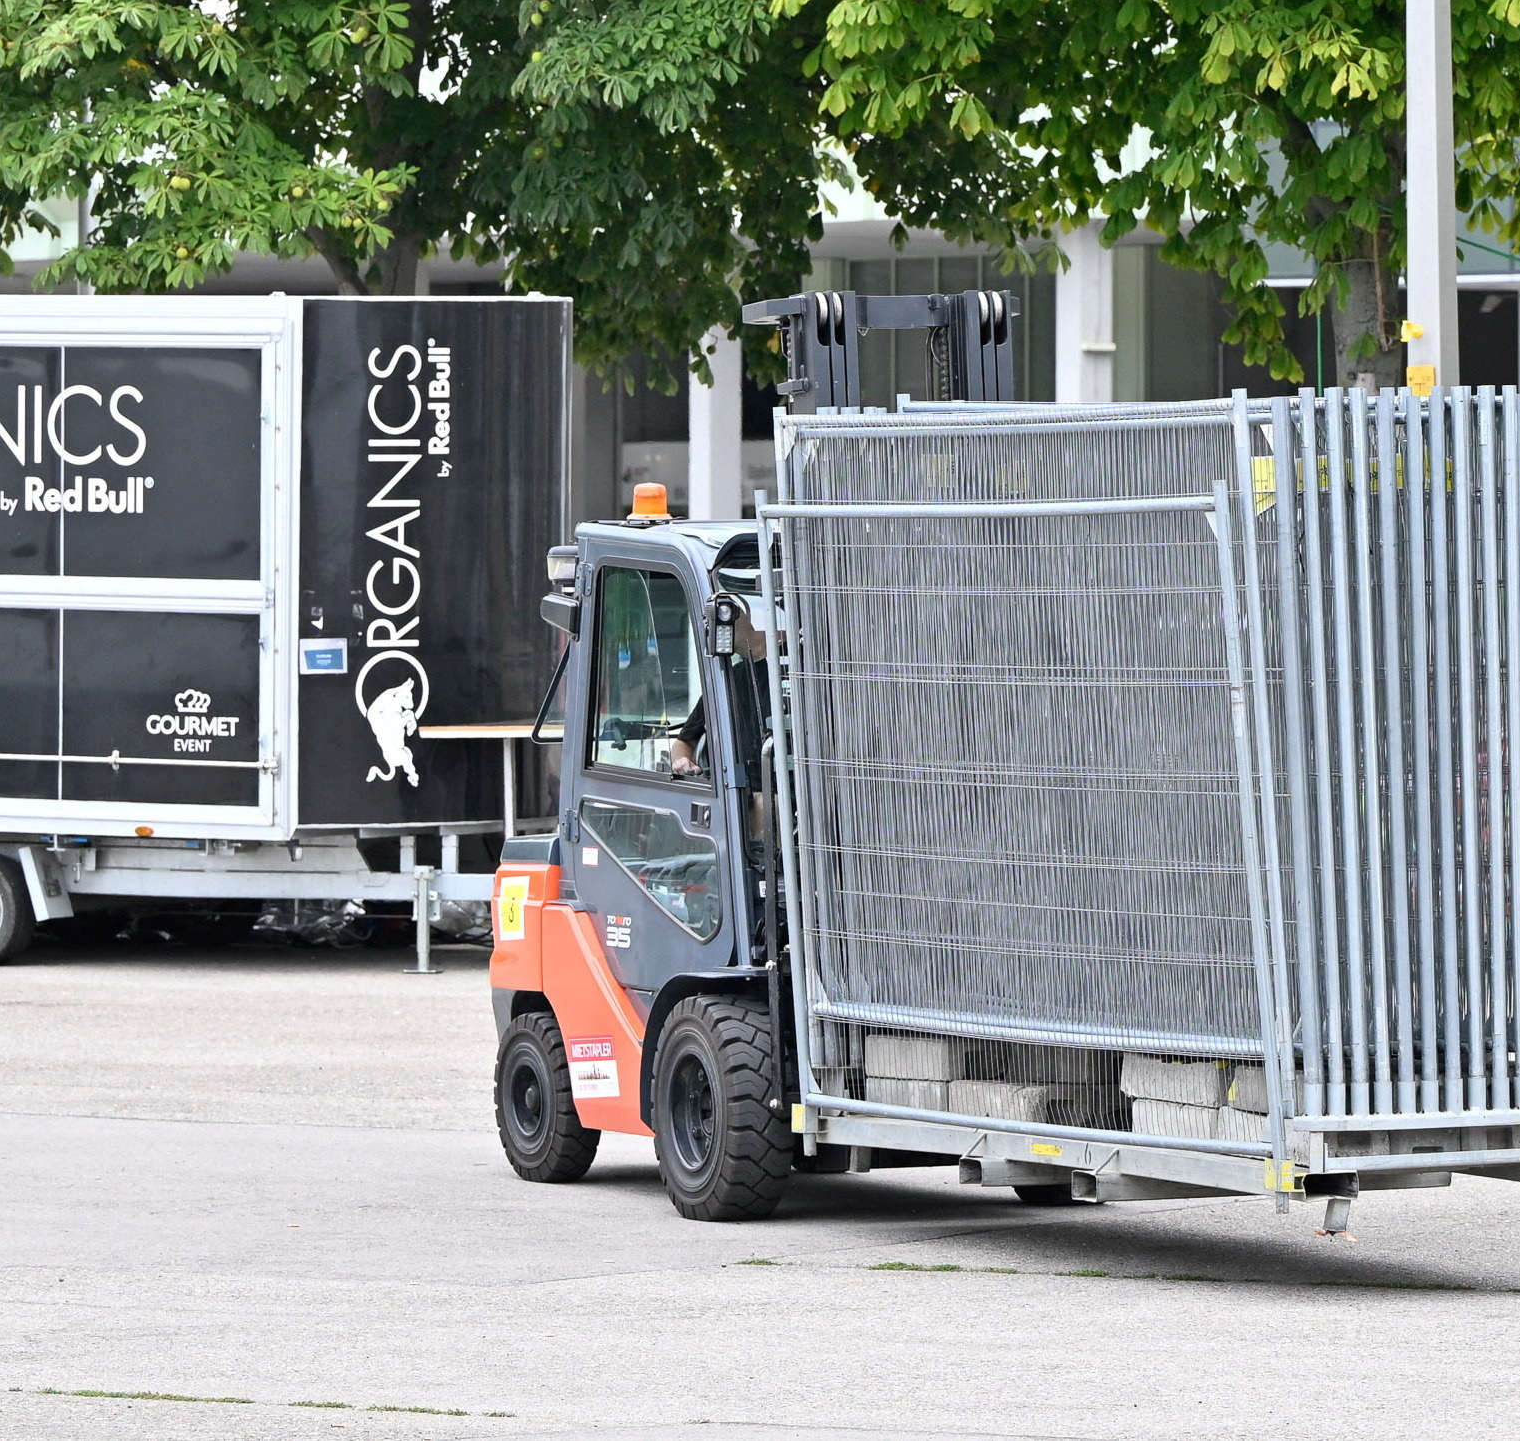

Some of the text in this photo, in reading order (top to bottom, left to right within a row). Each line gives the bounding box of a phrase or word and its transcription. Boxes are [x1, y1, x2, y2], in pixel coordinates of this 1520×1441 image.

[428, 402, 452, 455] Red
[437, 460, 453, 478] by
[0, 490, 19, 517] by
[25, 475, 83, 513] Red
[355, 344, 430, 721] ORGANICS
[146, 714, 240, 736] GOURMET
[174, 739, 212, 752] EVENT
[606, 926, 631, 949] 35
[571, 1042, 612, 1059] MIETSTAPLER
